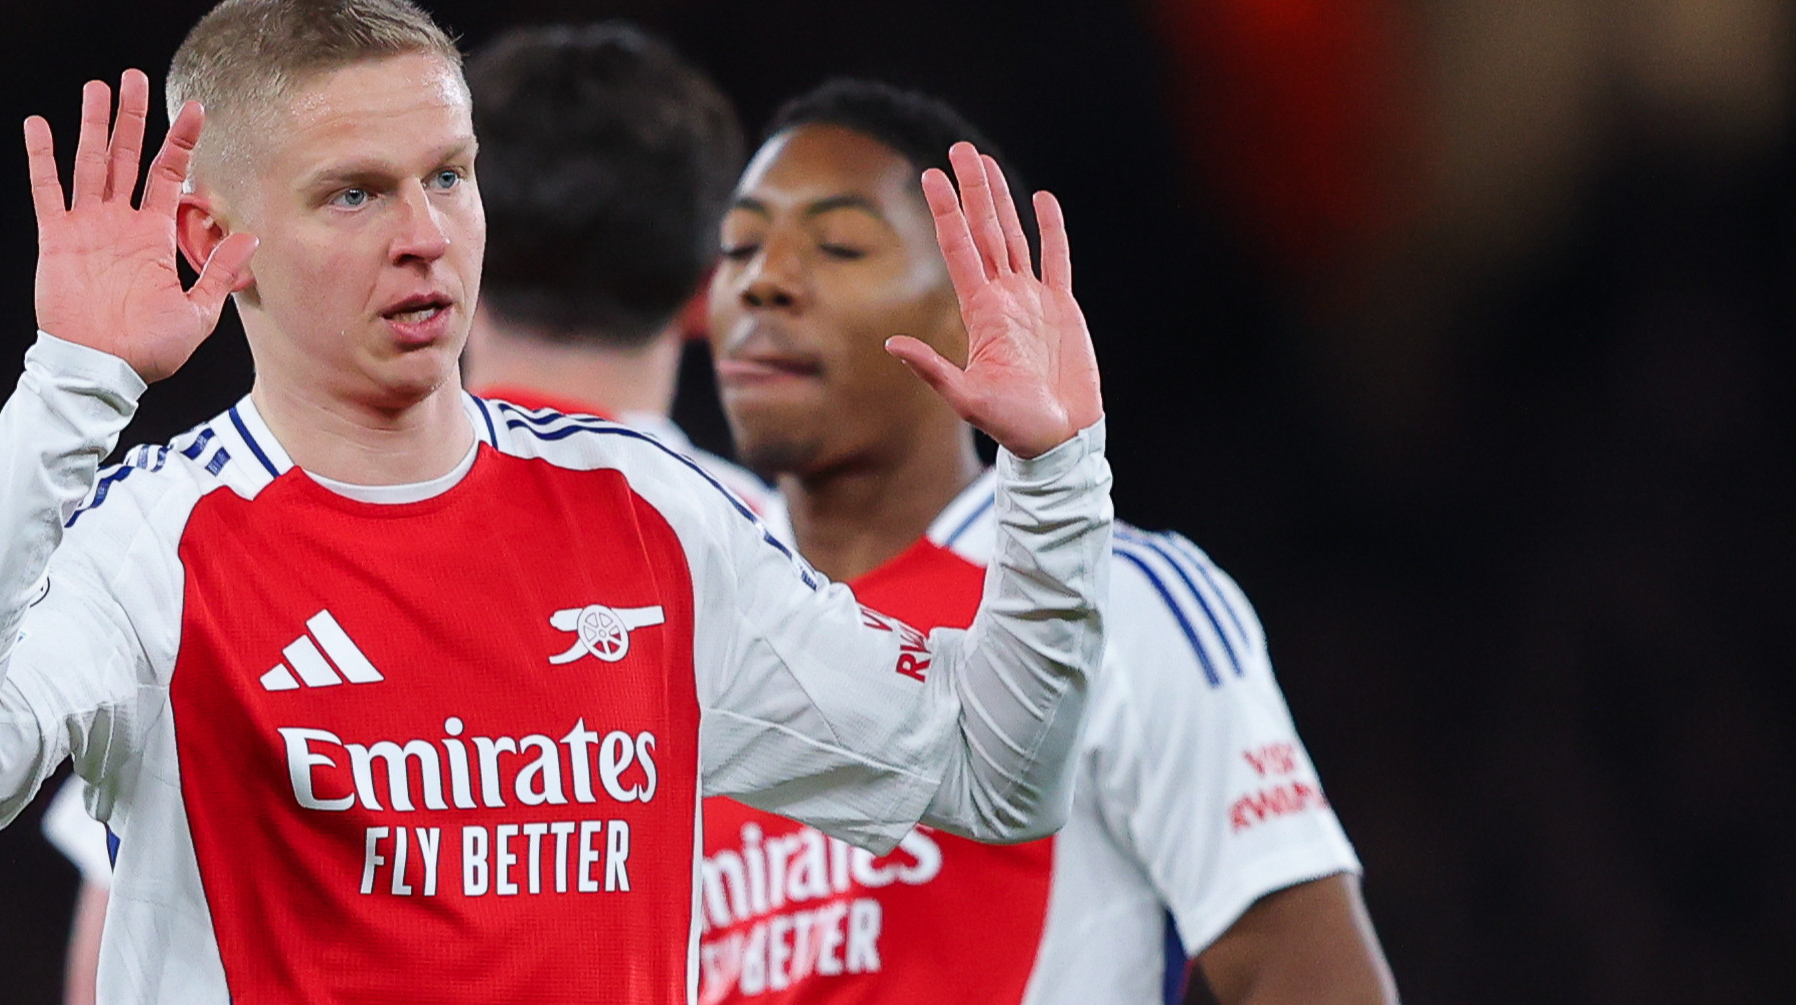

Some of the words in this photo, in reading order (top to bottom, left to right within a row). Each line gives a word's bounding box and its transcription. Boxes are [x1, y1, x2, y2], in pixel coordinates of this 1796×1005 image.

[277, 716, 659, 812] Emirates
[359, 826, 440, 897] FLY
[461, 819, 632, 897] BETTER
[702, 820, 944, 934] mirates
